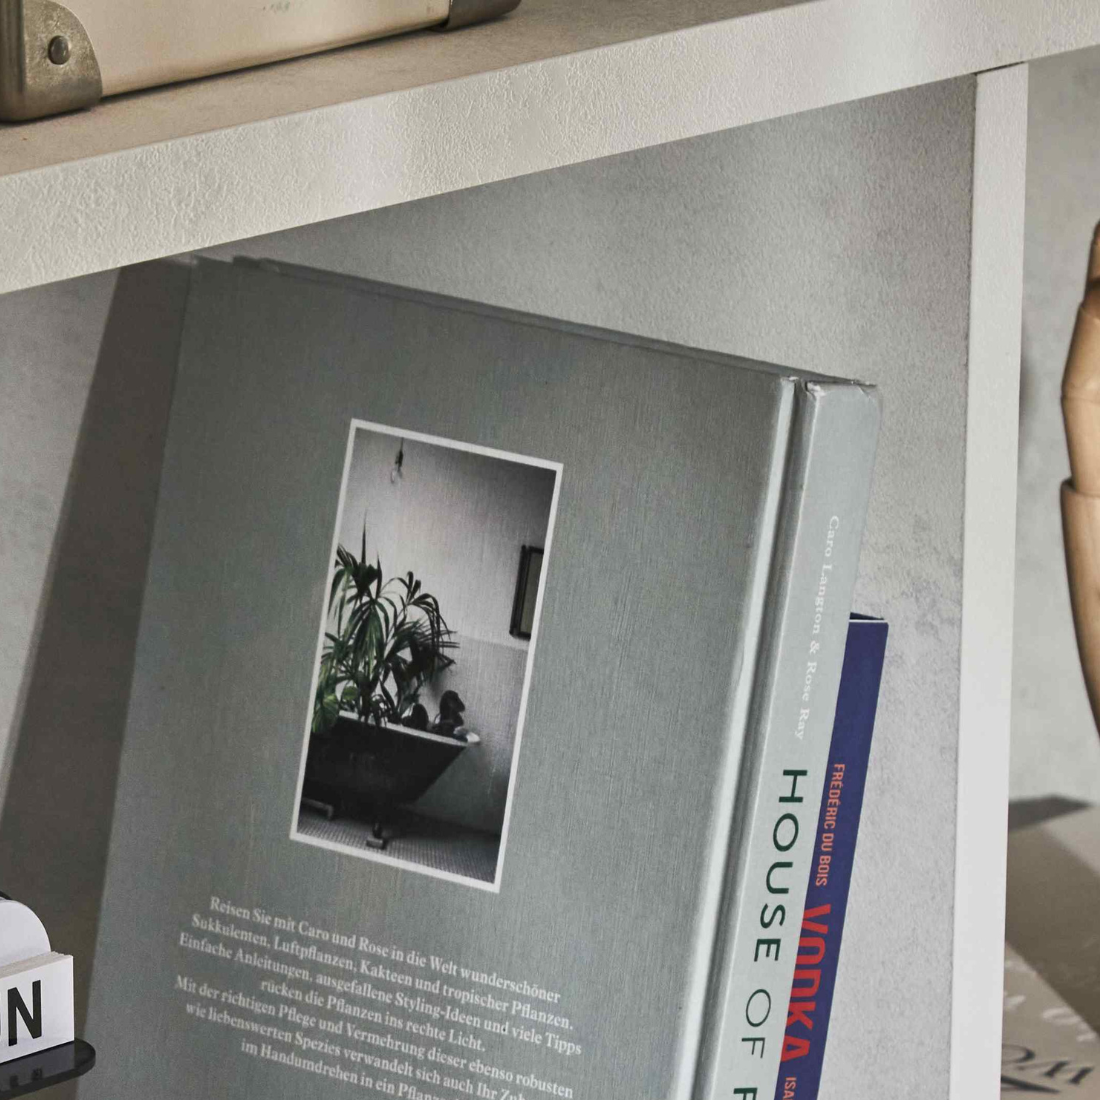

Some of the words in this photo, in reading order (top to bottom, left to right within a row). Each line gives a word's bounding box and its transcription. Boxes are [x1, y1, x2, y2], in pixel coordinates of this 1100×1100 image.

[823, 515, 840, 558] Caro
[812, 563, 833, 635] Langton
[803, 660, 818, 702] Rose
[809, 640, 820, 654] &
[794, 706, 810, 740] Ray
[823, 763, 846, 829] FRÉDÉRIC
[753, 769, 808, 963] HOUSE
[815, 855, 832, 887] BOIS
[820, 832, 835, 852] DU
[192, 913, 270, 948] Sukkulenten,
[273, 935, 357, 972] Luftpflanzen,
[359, 959, 413, 987] Kakteen
[415, 976, 440, 994] und
[442, 984, 509, 1012] tropischer
[511, 1000, 573, 1030] Pflanzen.
[210, 896, 250, 920] Reisen
[252, 908, 271, 926] Sie
[274, 914, 295, 931] mit
[298, 921, 330, 941] Caro
[332, 929, 356, 949] und
[358, 936, 389, 957] Rose
[391, 946, 404, 962] in
[406, 950, 426, 968] die
[429, 955, 458, 976] Welt
[460, 967, 561, 1004] wunderschöner
[780, 903, 832, 1063] VODKA
[179, 931, 233, 960] Einfache
[234, 948, 313, 982] Anleitungen,
[316, 972, 393, 1003] ausgefallene
[394, 991, 481, 1029] Styling-Ideen
[483, 1018, 509, 1036] und
[511, 1025, 543, 1045] viele
[544, 1031, 581, 1056] Tipps
[259, 978, 302, 1000] rücken
[304, 988, 325, 1007] die
[326, 995, 382, 1025] Pflanzen
[384, 1010, 404, 1030] ins
[405, 1018, 447, 1041] rechte
[448, 1028, 485, 1052] Licht.
[741, 988, 772, 1059] OF
[174, 974, 197, 993] Mit
[198, 982, 220, 1000] der
[220, 988, 276, 1016] richtigen
[278, 1003, 317, 1028] Pflege
[318, 1017, 343, 1035] und
[345, 1022, 426, 1060] Vermehrung
[427, 1045, 467, 1069] dieser
[468, 1059, 514, 1082] ebenso
[515, 1072, 574, 1099] robusten
[185, 1002, 207, 1019] wie
[208, 1006, 293, 1044] liebenswerten
[294, 1031, 341, 1057] Spezies
[343, 1047, 413, 1077] verwandelt
[415, 1066, 441, 1085] sich
[442, 1075, 474, 1094] auch
[476, 1081, 498, 1100] Ihr
[240, 1037, 258, 1057] im
[259, 1043, 358, 1086] Handumdrehen
[360, 1071, 374, 1089] in
[375, 1077, 395, 1096] ein
